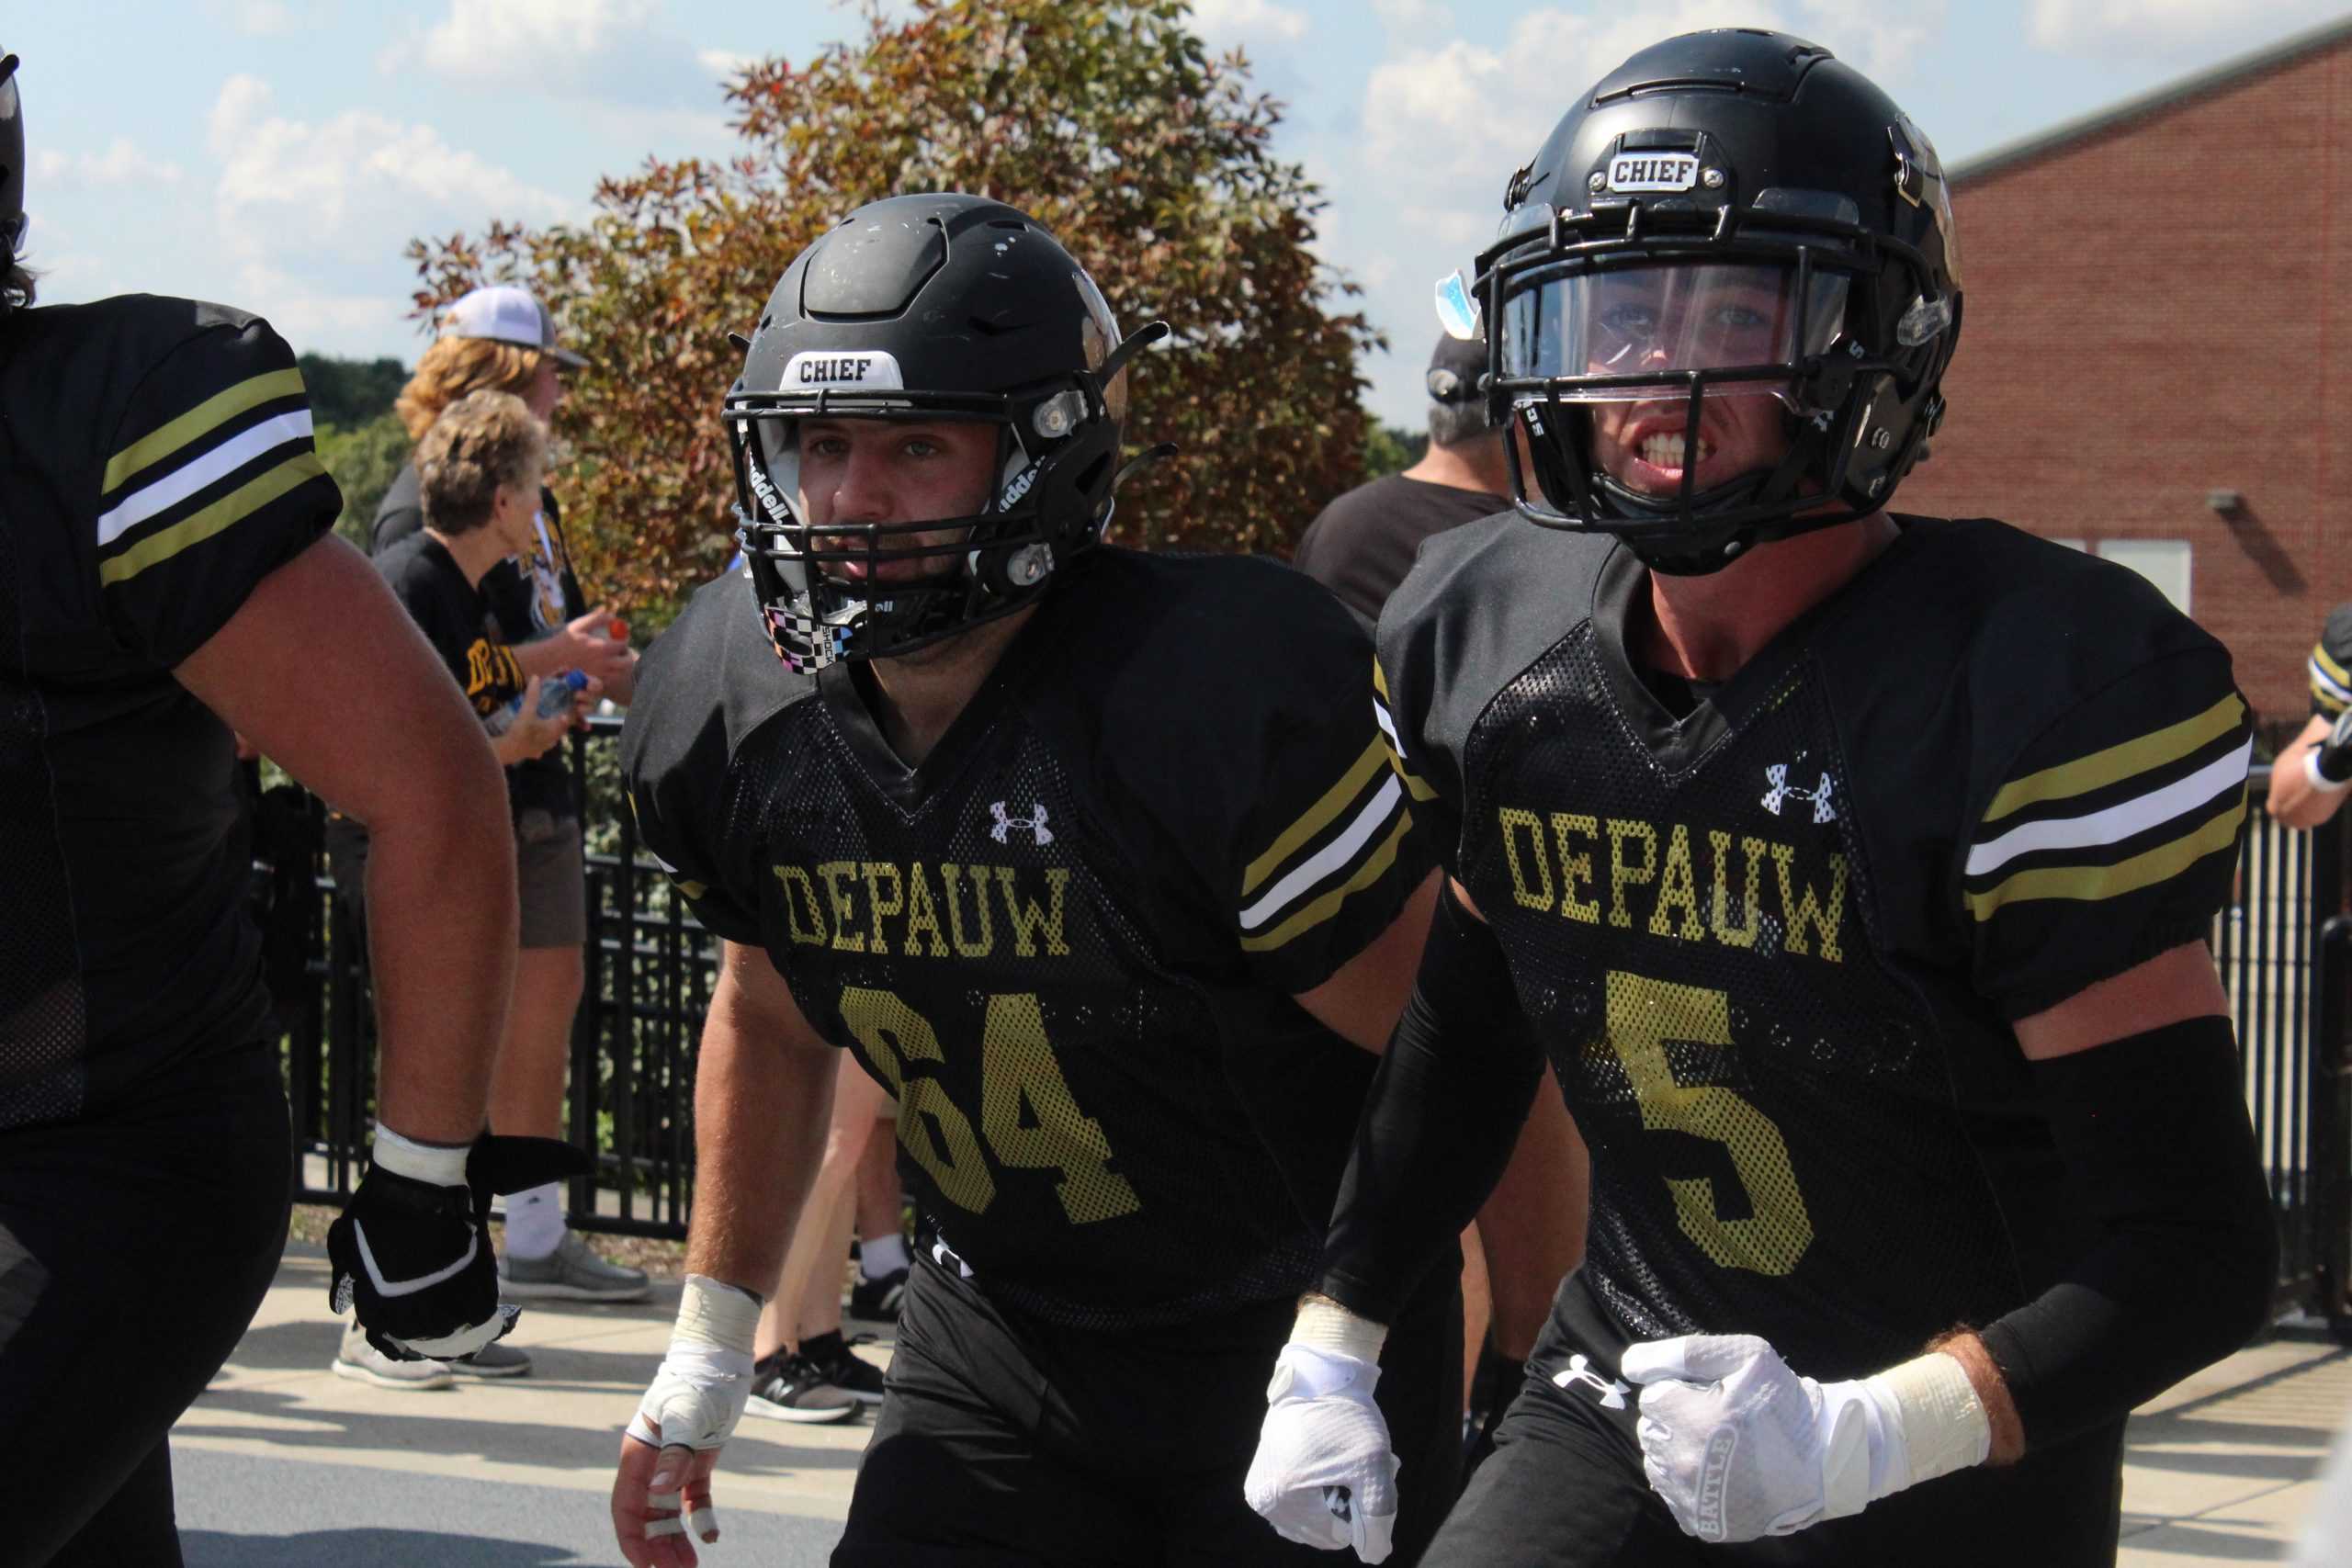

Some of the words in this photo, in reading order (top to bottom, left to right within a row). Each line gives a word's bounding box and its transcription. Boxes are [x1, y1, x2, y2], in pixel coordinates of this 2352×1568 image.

[1614, 161, 1693, 183] CHIEF
[800, 358, 872, 383] CHIEF
[773, 861, 1070, 957] DEPAUW
[1499, 807, 1849, 963] DEPAUW
[839, 985, 1142, 1224] 64
[1605, 969, 1815, 1277] 5
[1700, 1438, 1735, 1535] BATTLE
